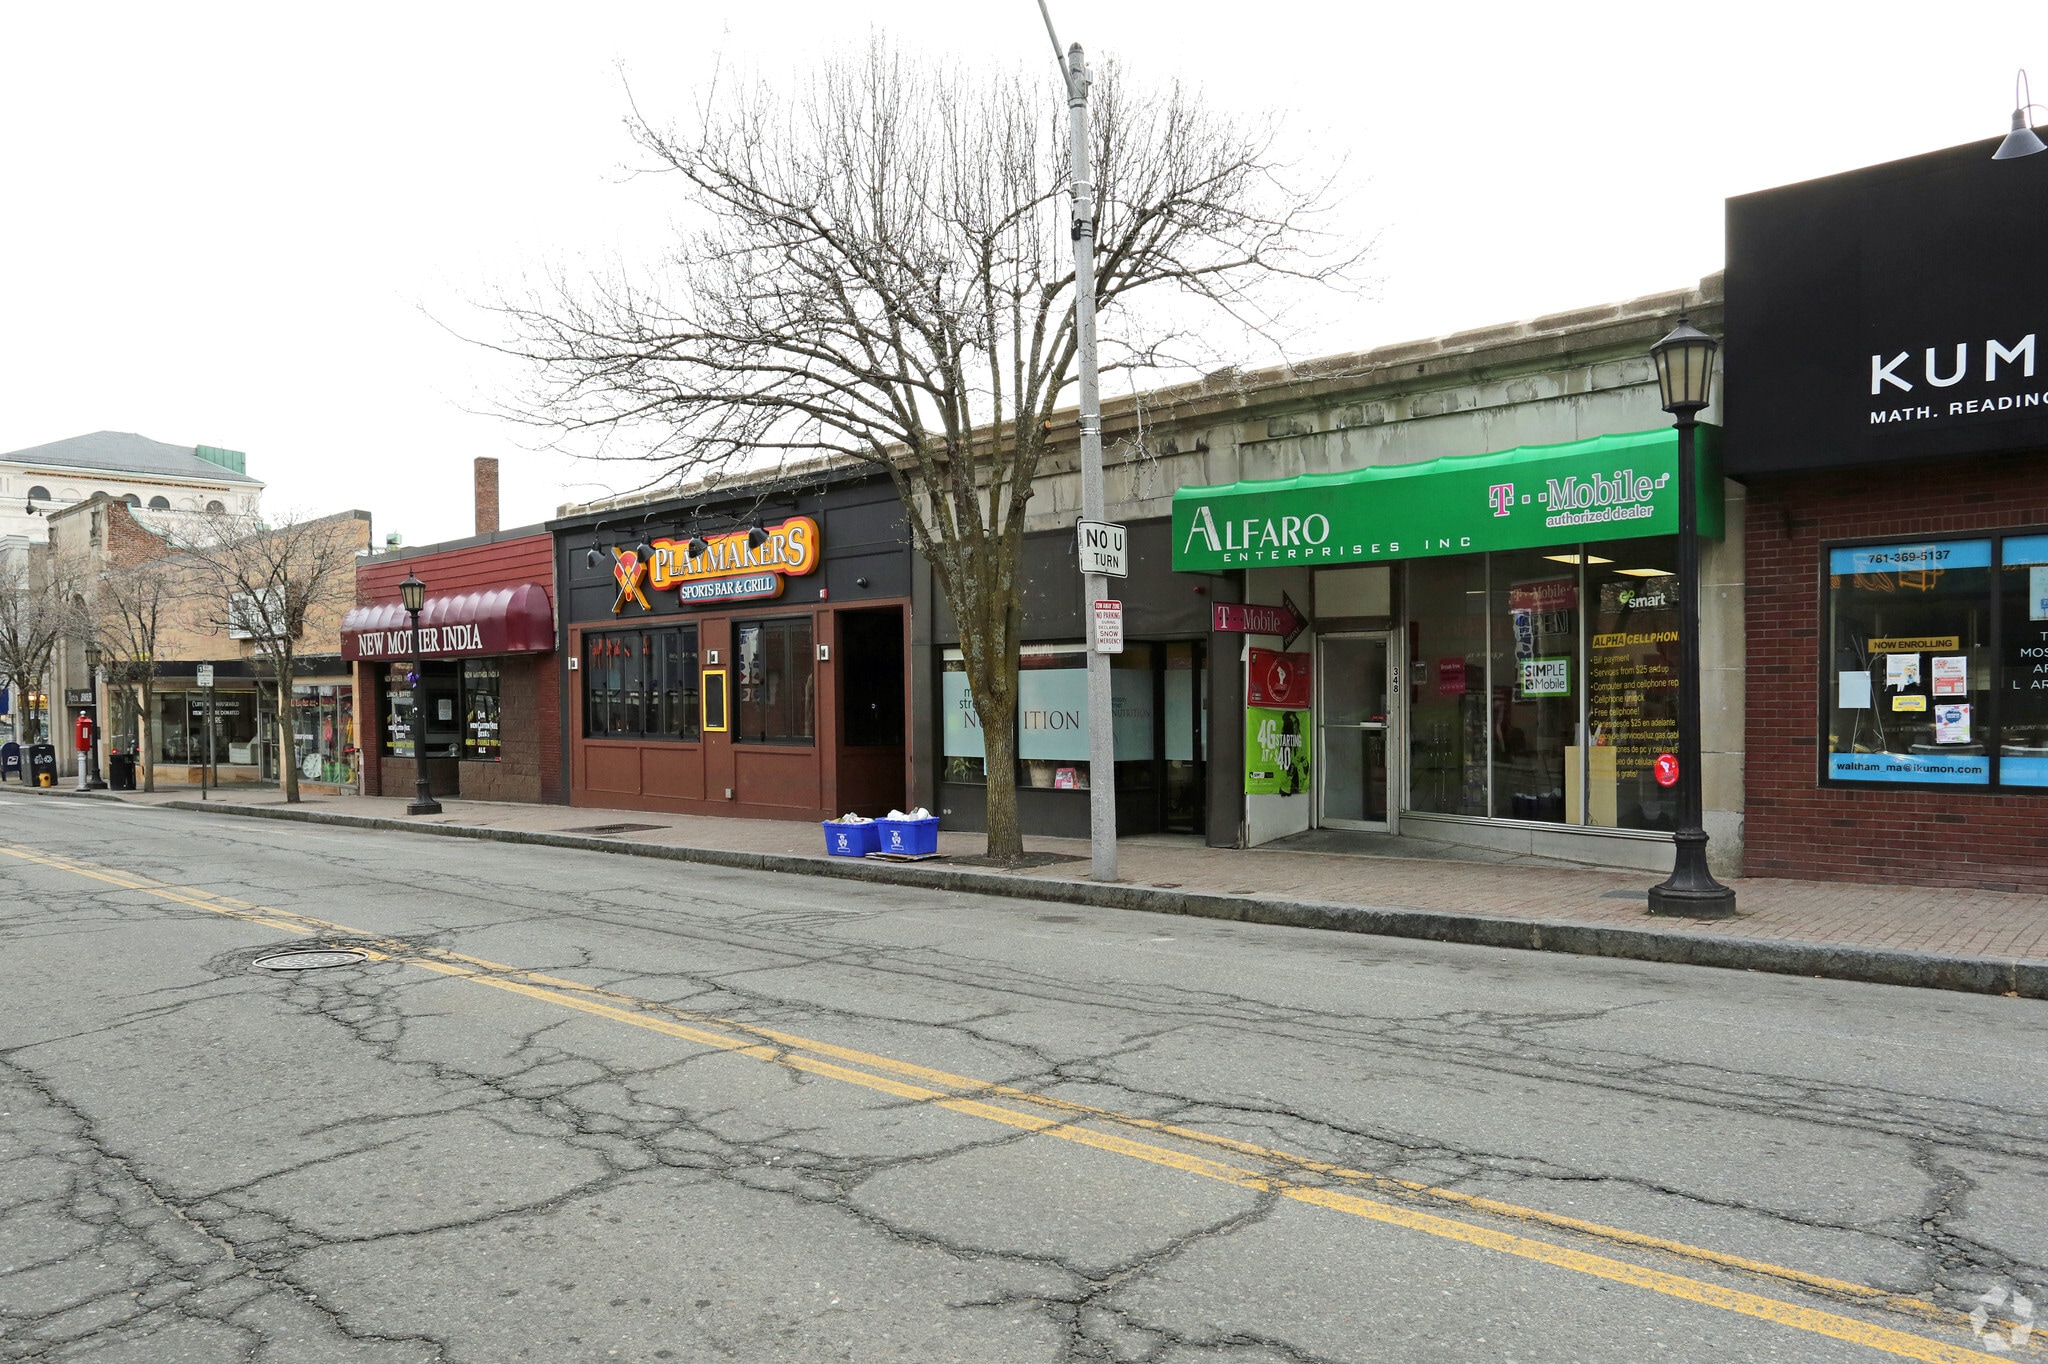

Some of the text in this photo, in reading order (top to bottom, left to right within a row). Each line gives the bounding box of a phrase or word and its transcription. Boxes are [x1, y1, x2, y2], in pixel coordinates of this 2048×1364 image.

[1871, 334, 2035, 395] KUM
[1870, 406, 1938, 424] MATH.
[1546, 505, 1654, 527] authorized dealer
[1184, 506, 1330, 553] ALFARO
[1086, 529, 1122, 551] NO U
[654, 527, 806, 582] PLAYMAKERS
[1224, 537, 1471, 562] ENTERPRISES INC
[1094, 552, 1119, 568] TURN
[1868, 550, 1950, 564] 781-369-5137
[682, 578, 773, 599] SPORTS BAR & GRILL
[1629, 592, 1666, 608] smart
[358, 632, 384, 656] NEW
[442, 624, 482, 651] INDIA
[1593, 631, 1679, 648] ALPHA CELLPHON
[1874, 639, 1952, 649] NOW ENROLLING
[1593, 654, 1630, 665] Bill payment
[1525, 663, 1565, 677] SIMPLE
[1593, 667, 1619, 677] Services
[1620, 666, 1635, 675] from
[1635, 664, 1647, 674] $25
[1535, 679, 1565, 690] Mobile
[1593, 682, 1622, 691] Computer
[1624, 680, 1636, 689] and
[1636, 678, 1666, 689] cellphone
[1593, 693, 1645, 704] Cellphone unlock
[1594, 708, 1608, 717] Free
[1631, 718, 1641, 727] $25
[1651, 718, 1676, 727] adelante
[1276, 733, 1302, 747] STARTING
[1262, 749, 1270, 762] AT
[1837, 762, 1982, 774] waltham_ma@ikumon.com
